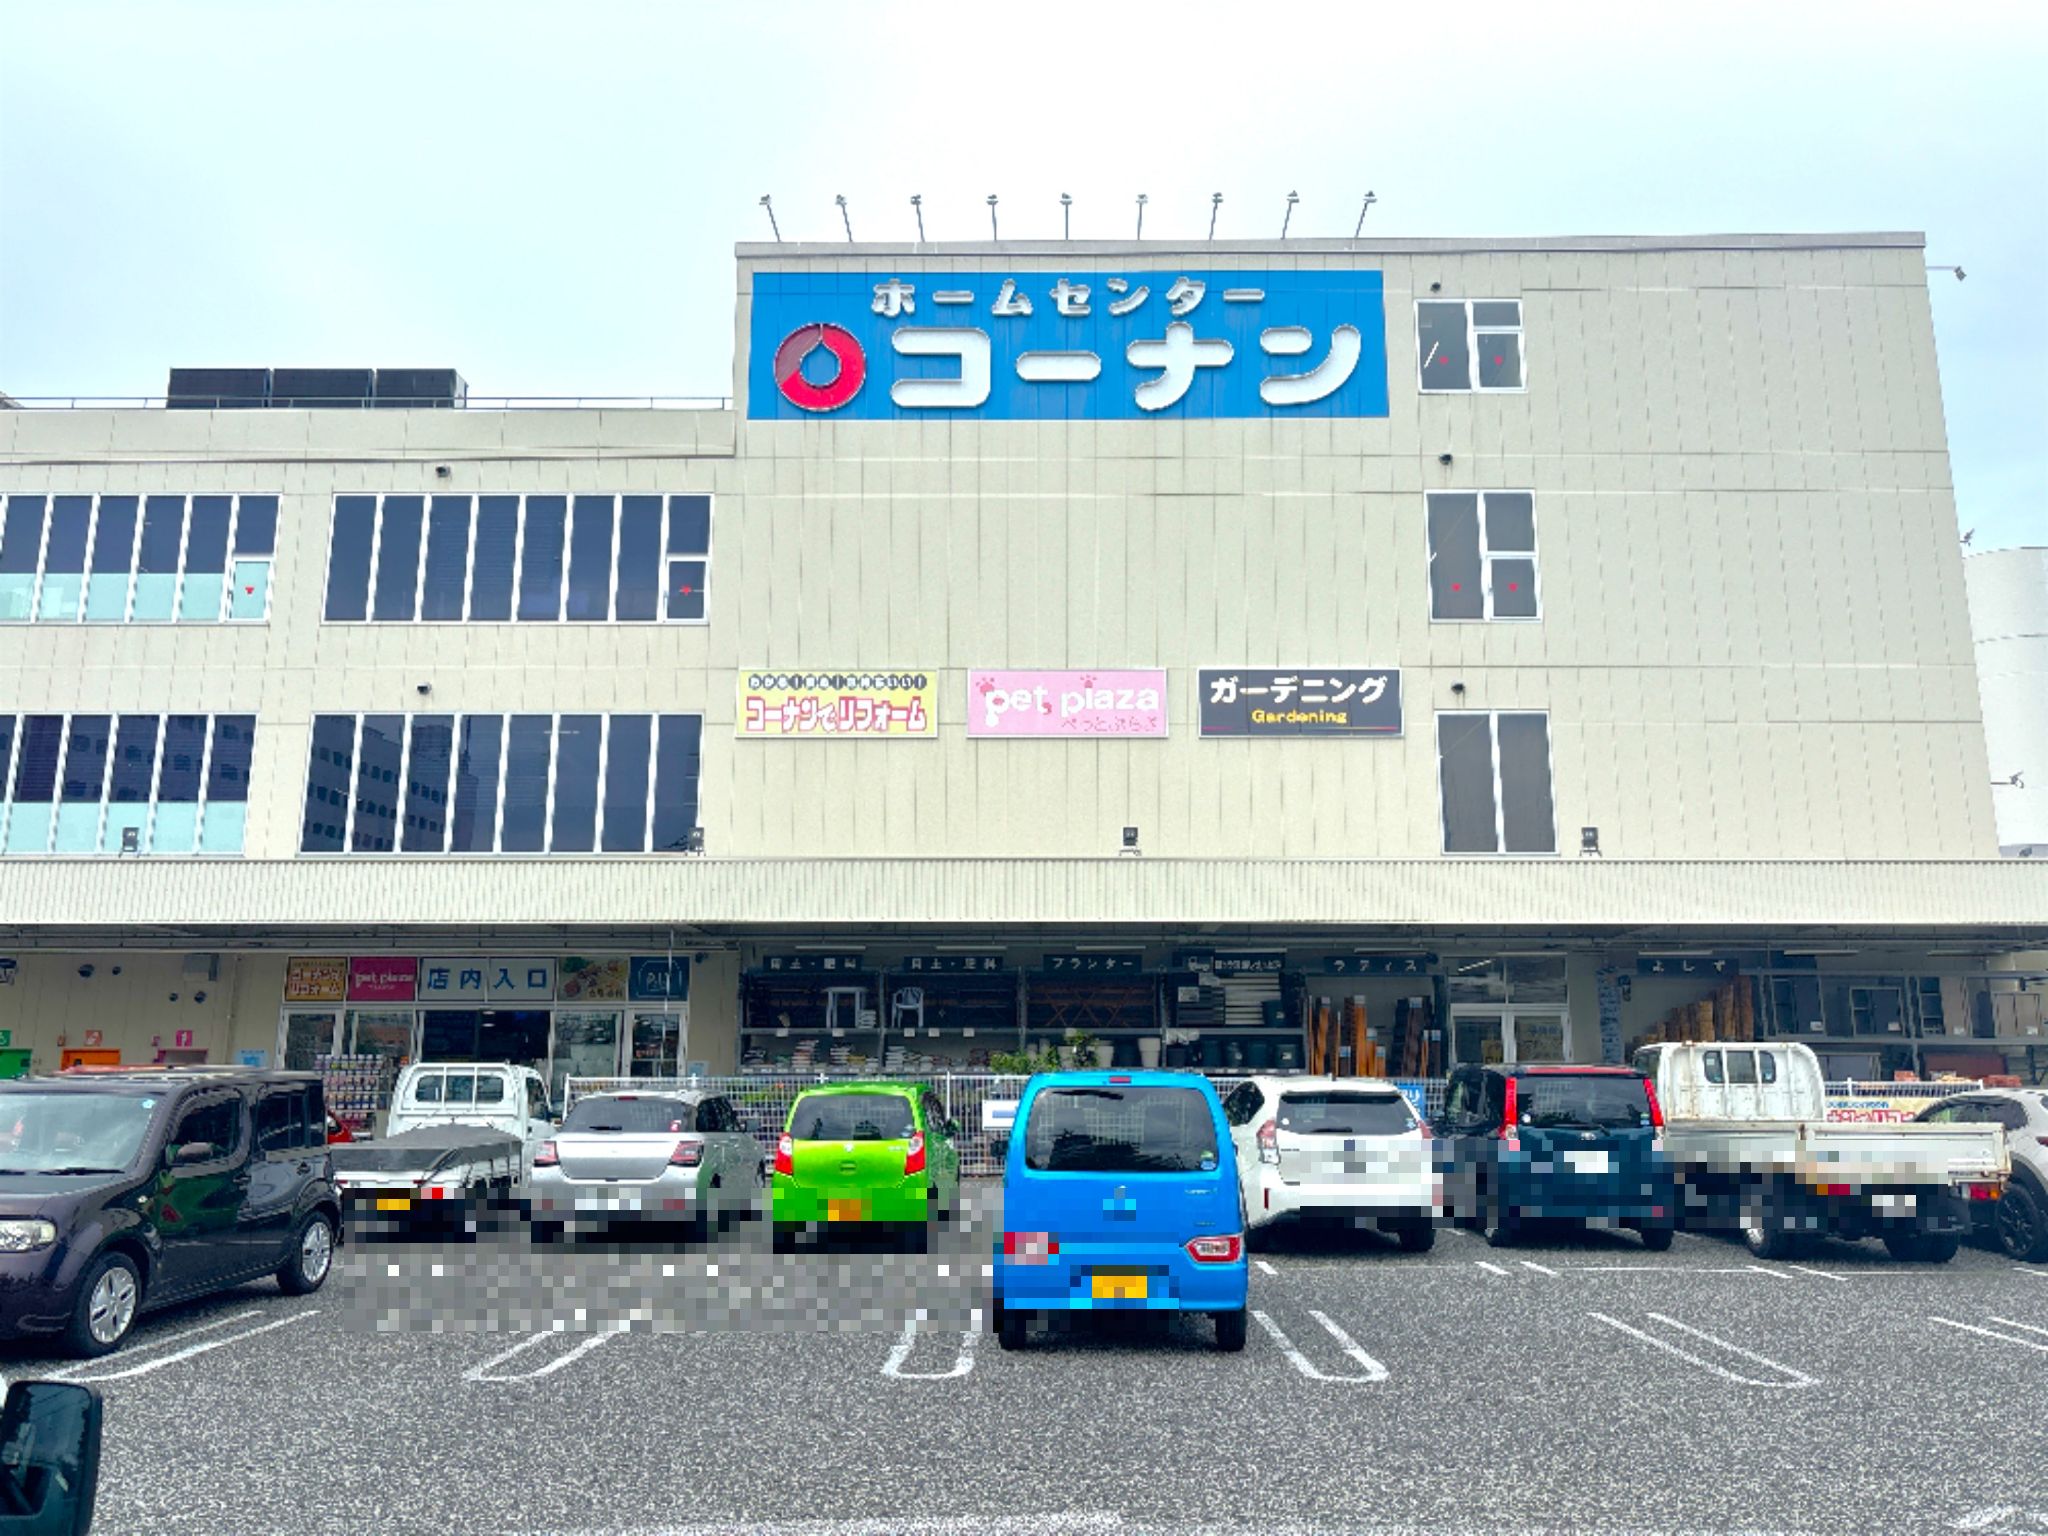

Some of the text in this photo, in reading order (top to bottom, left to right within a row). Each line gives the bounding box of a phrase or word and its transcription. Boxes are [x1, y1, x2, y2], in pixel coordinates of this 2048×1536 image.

[871, 277, 1266, 318] ホームセンター
[890, 321, 1362, 411] コーナン
[984, 684, 1160, 728] pet plaza
[1210, 675, 1389, 704] ガーデニング
[746, 696, 927, 733] コーナンでリフォーム
[1251, 708, 1348, 724] Gardening
[427, 966, 548, 990] 店内入口
[1652, 959, 1726, 973] よしず
